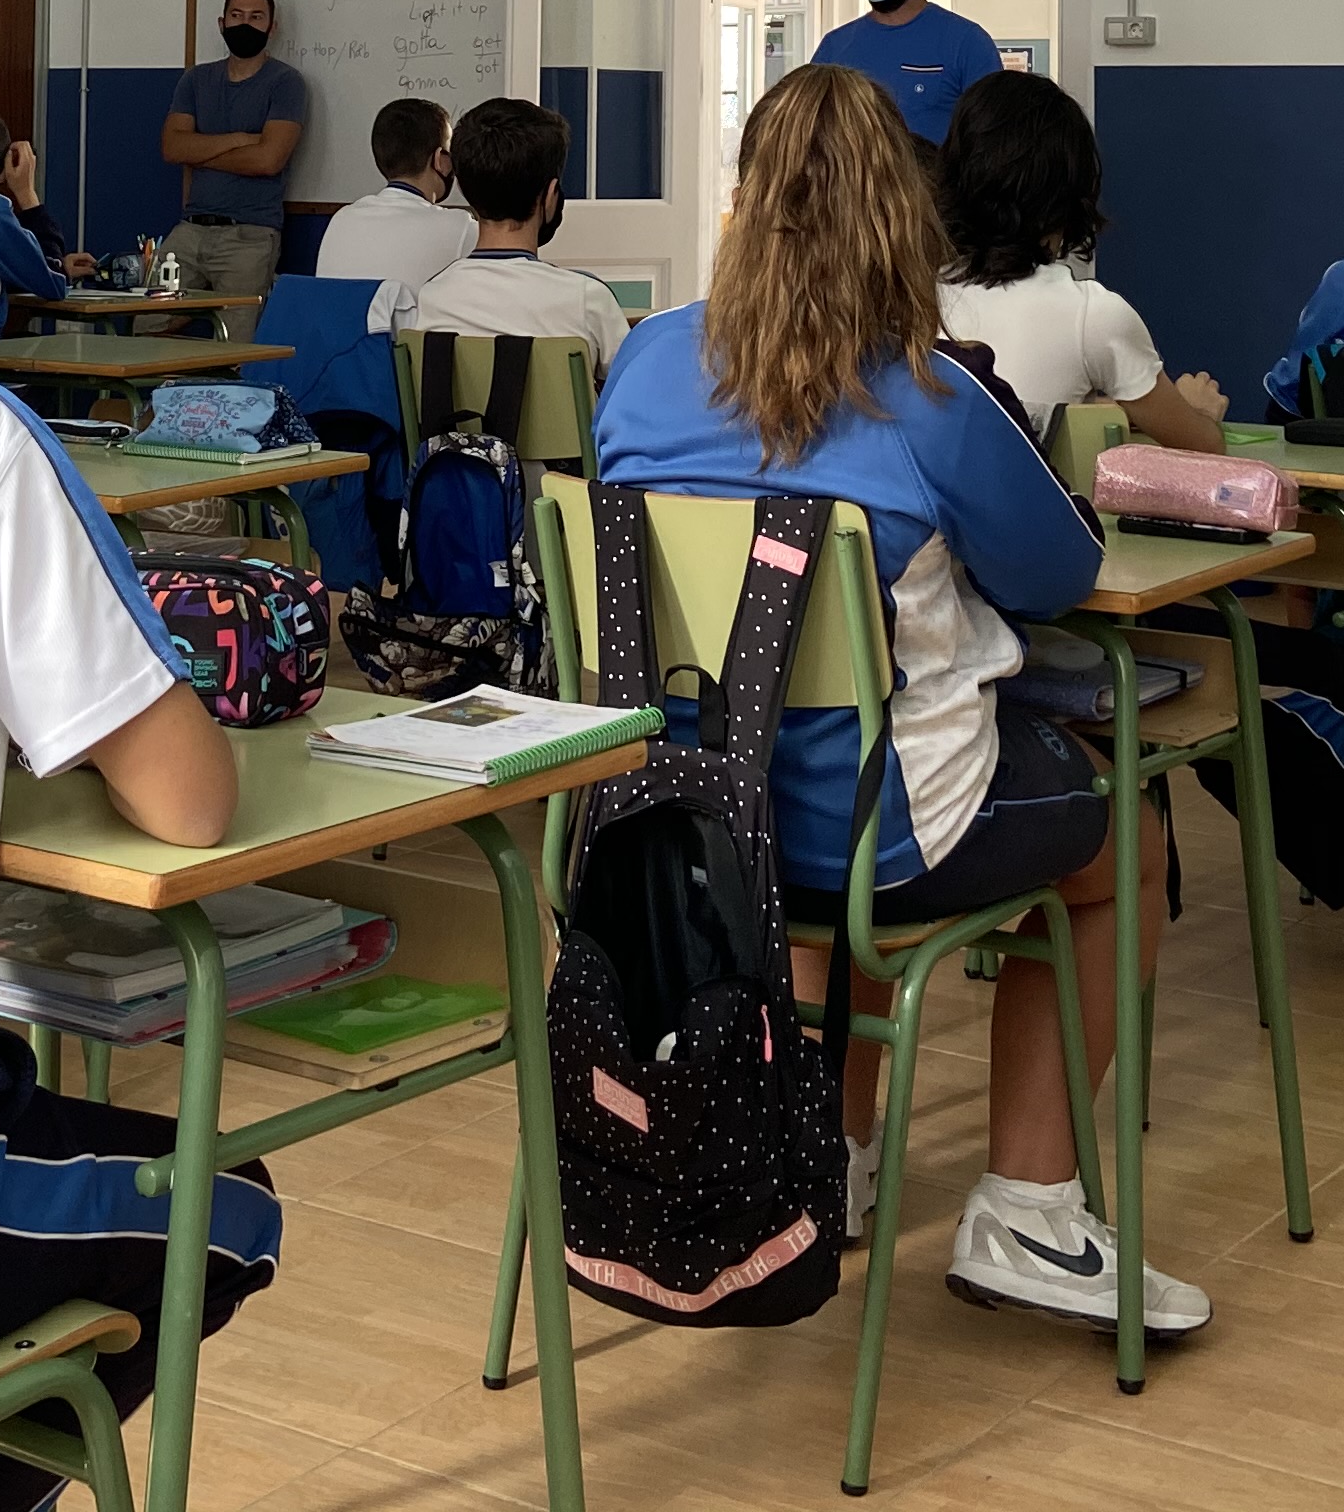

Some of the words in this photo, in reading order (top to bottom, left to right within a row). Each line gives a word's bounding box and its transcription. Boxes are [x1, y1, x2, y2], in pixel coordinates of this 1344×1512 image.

[409, 0, 446, 28] Light
[470, 5, 487, 22] up
[472, 33, 502, 60] get
[475, 59, 500, 83] got
[636, 1275, 691, 1310] TENTH
[712, 1257, 769, 1299] TENTH
